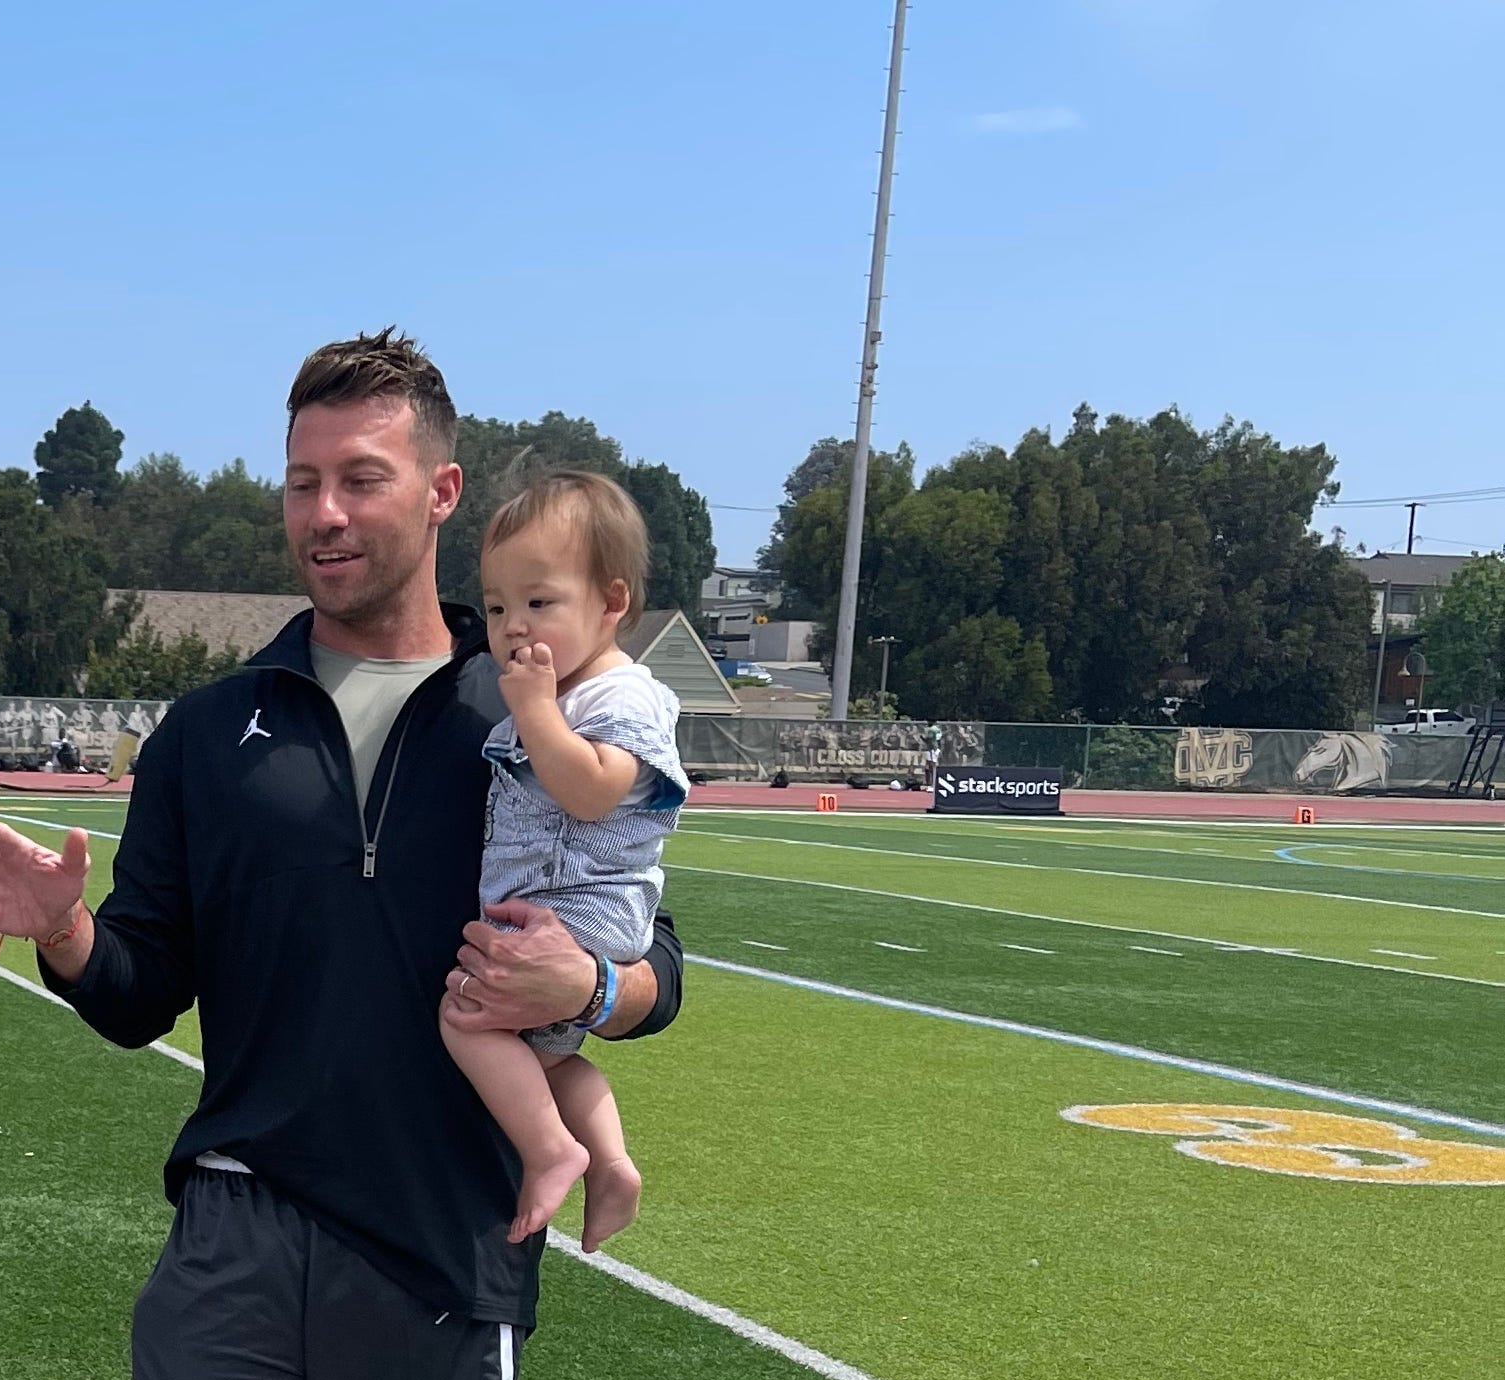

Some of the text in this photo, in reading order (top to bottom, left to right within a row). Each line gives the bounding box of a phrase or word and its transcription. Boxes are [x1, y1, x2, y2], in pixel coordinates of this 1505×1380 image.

[817, 749, 927, 766] CROSS COUNT
[958, 776, 1060, 798] stacksports
[821, 795, 835, 811] 10
[1301, 809, 1311, 824] G
